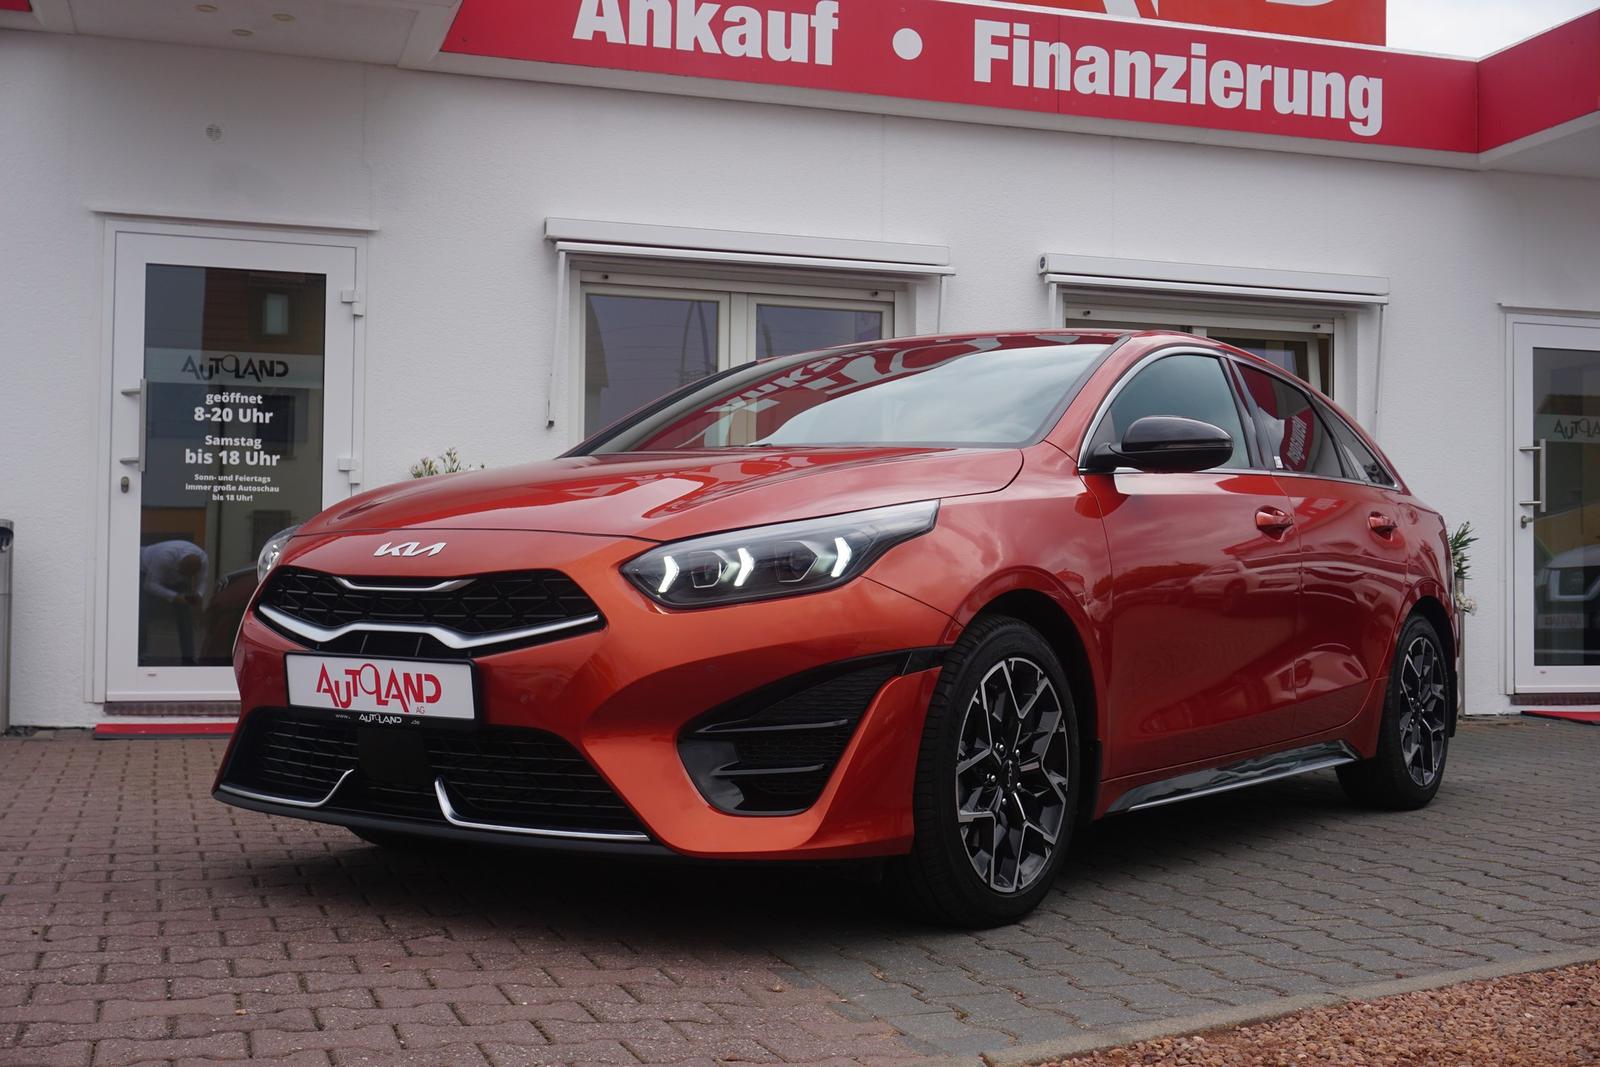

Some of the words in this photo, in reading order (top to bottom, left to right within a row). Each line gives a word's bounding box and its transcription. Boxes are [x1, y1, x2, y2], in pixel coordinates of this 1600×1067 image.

[572, 0, 839, 66] Ankauf
[973, 18, 1383, 137] Finanzierung
[205, 392, 263, 405] geöffnet
[193, 406, 233, 422] 8-20
[238, 407, 274, 424] Uhr
[204, 434, 262, 450] Samstag
[185, 448, 213, 464] bis
[218, 450, 241, 465] 18
[245, 450, 281, 466] Uhr
[194, 473, 217, 481] Sonn-
[235, 474, 271, 483] Feiertags
[213, 484, 237, 492] große
[238, 484, 280, 492] Autoschau
[212, 493, 224, 501] bis
[236, 494, 253, 502] Uhr!
[415, 705, 426, 715] AG
